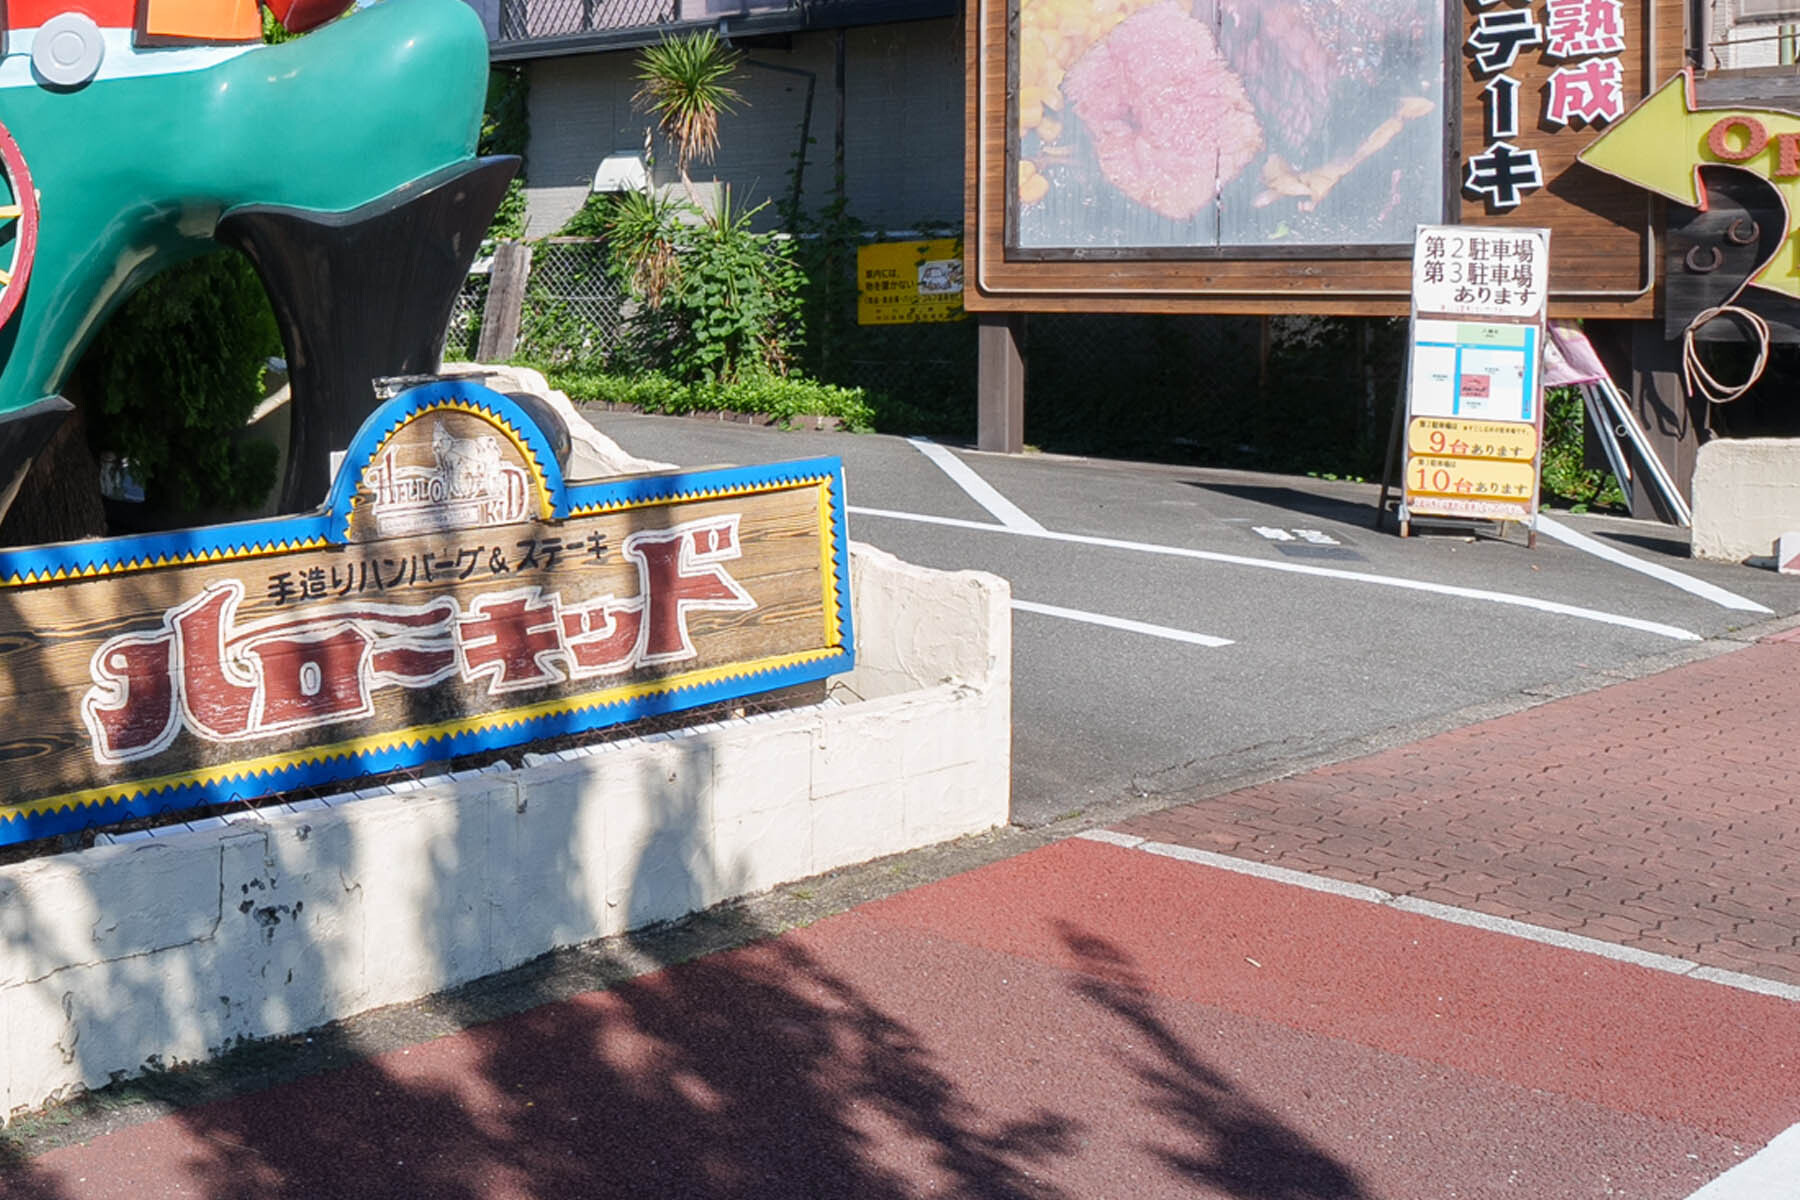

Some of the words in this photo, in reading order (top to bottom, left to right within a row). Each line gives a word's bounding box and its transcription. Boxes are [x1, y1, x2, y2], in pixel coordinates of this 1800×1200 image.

[1424, 236, 1535, 263] 第2駐車場
[1423, 260, 1533, 288] 第3駐車場
[1454, 286, 1537, 305] あります
[81, 513, 758, 765] ハローキッド
